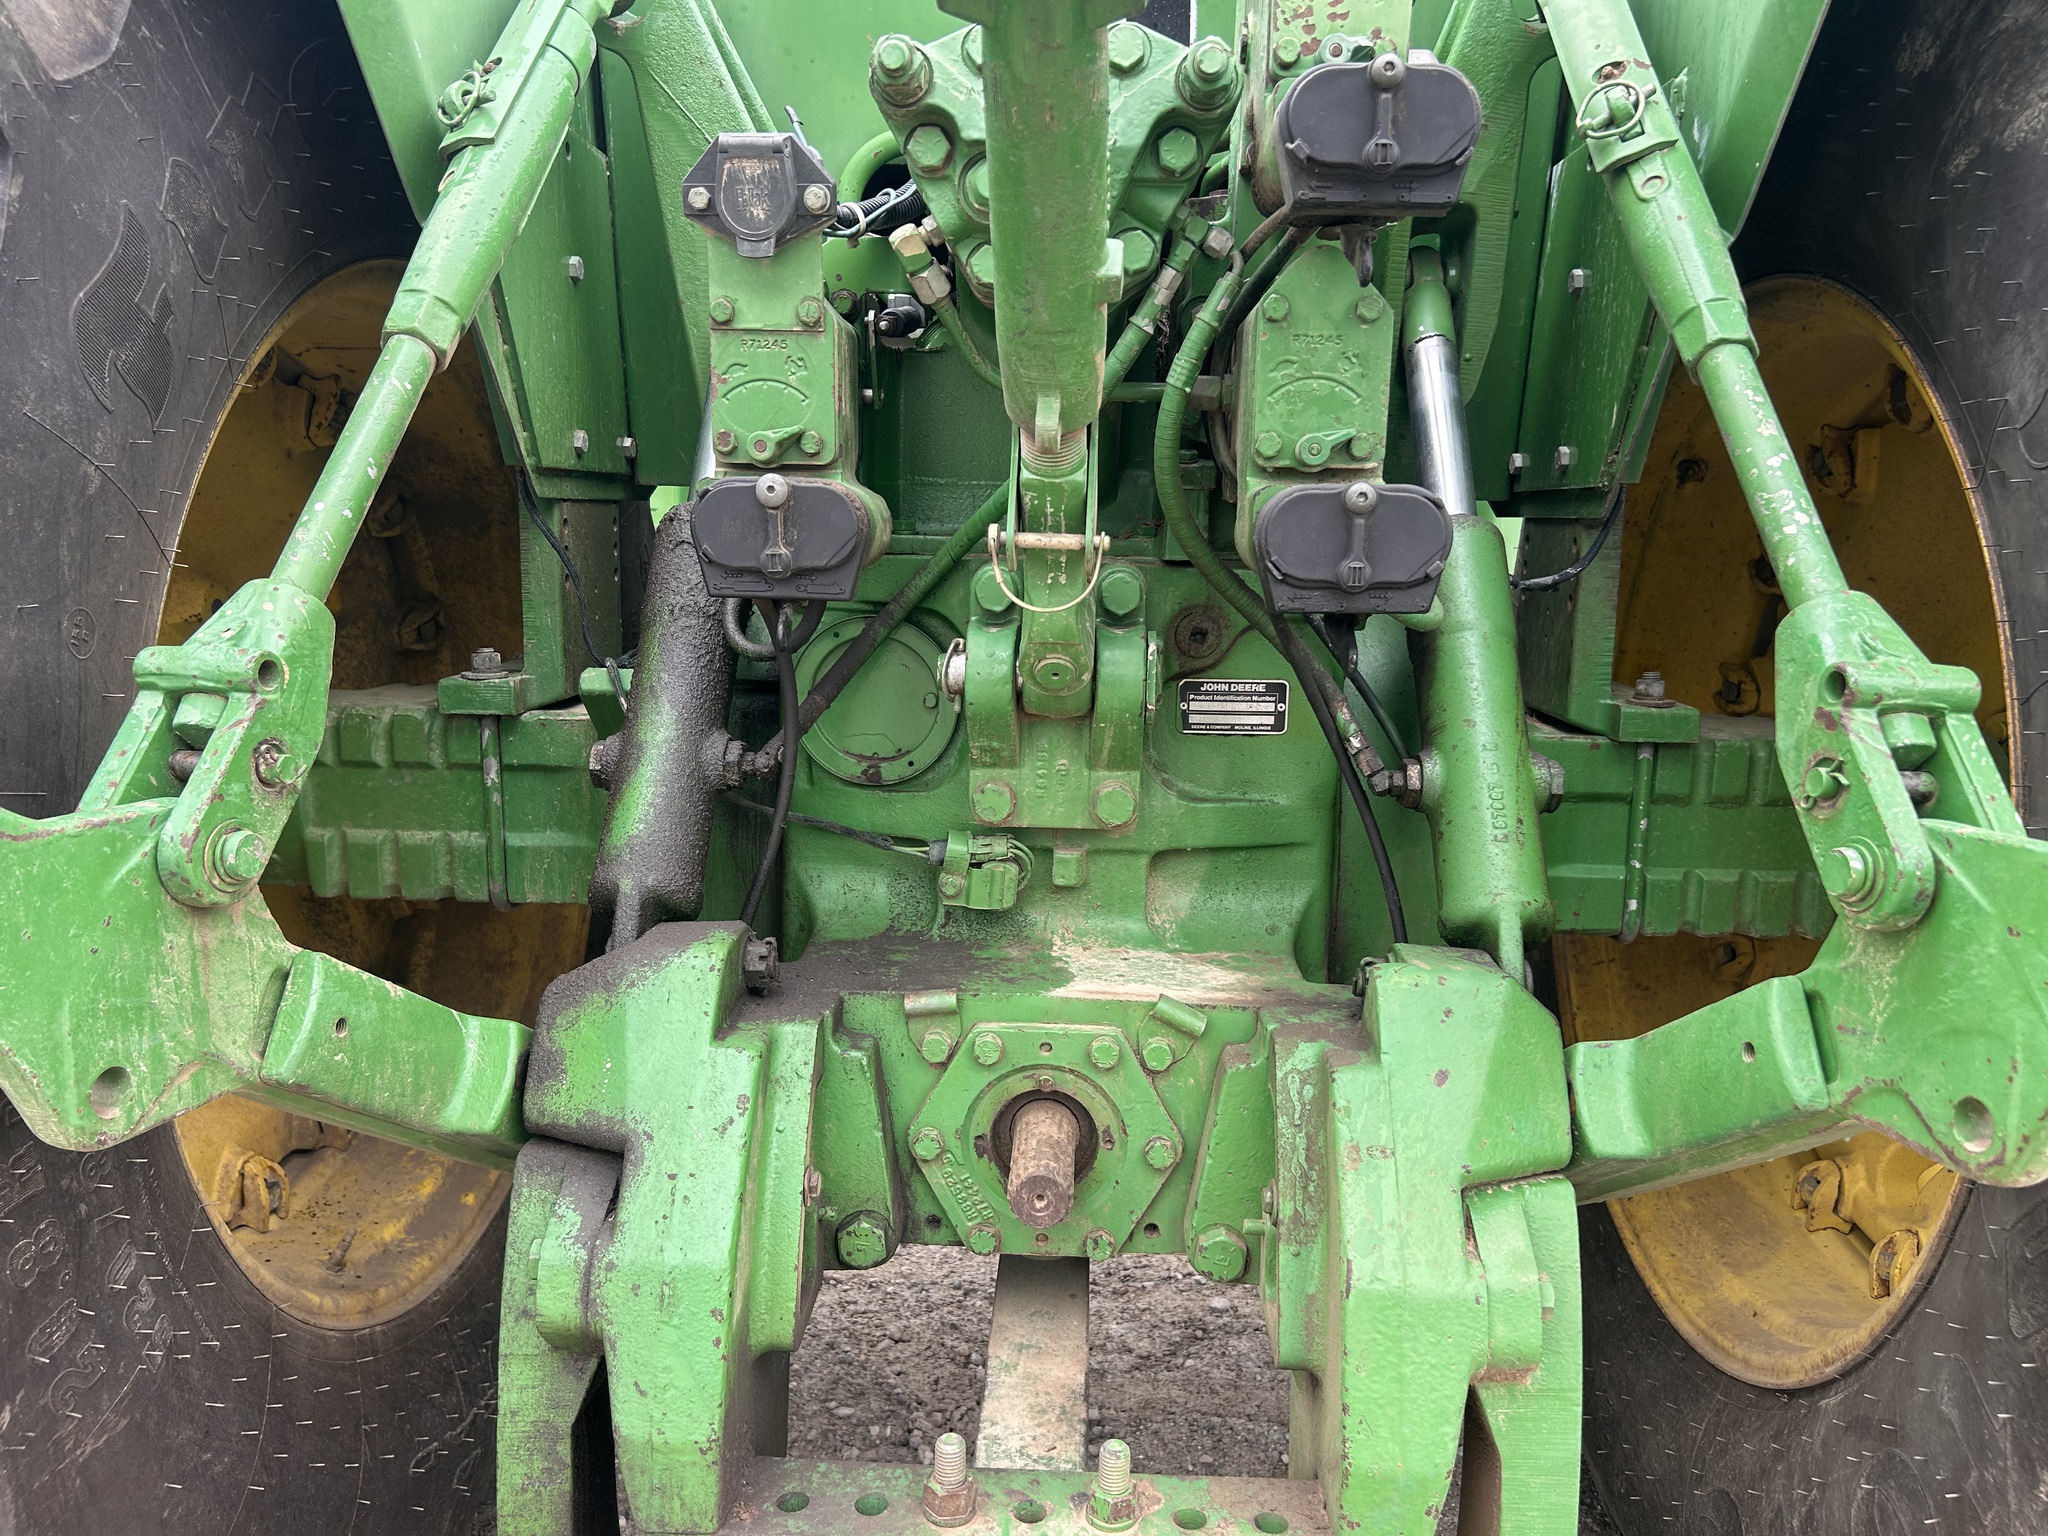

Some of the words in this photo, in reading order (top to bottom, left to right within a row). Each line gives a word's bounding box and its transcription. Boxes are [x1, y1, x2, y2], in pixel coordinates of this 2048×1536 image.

[741, 338, 788, 352] R71245
[1292, 333, 1342, 346] R71245
[1200, 683, 1229, 692] JOHN
[1230, 683, 1266, 692] DEERE
